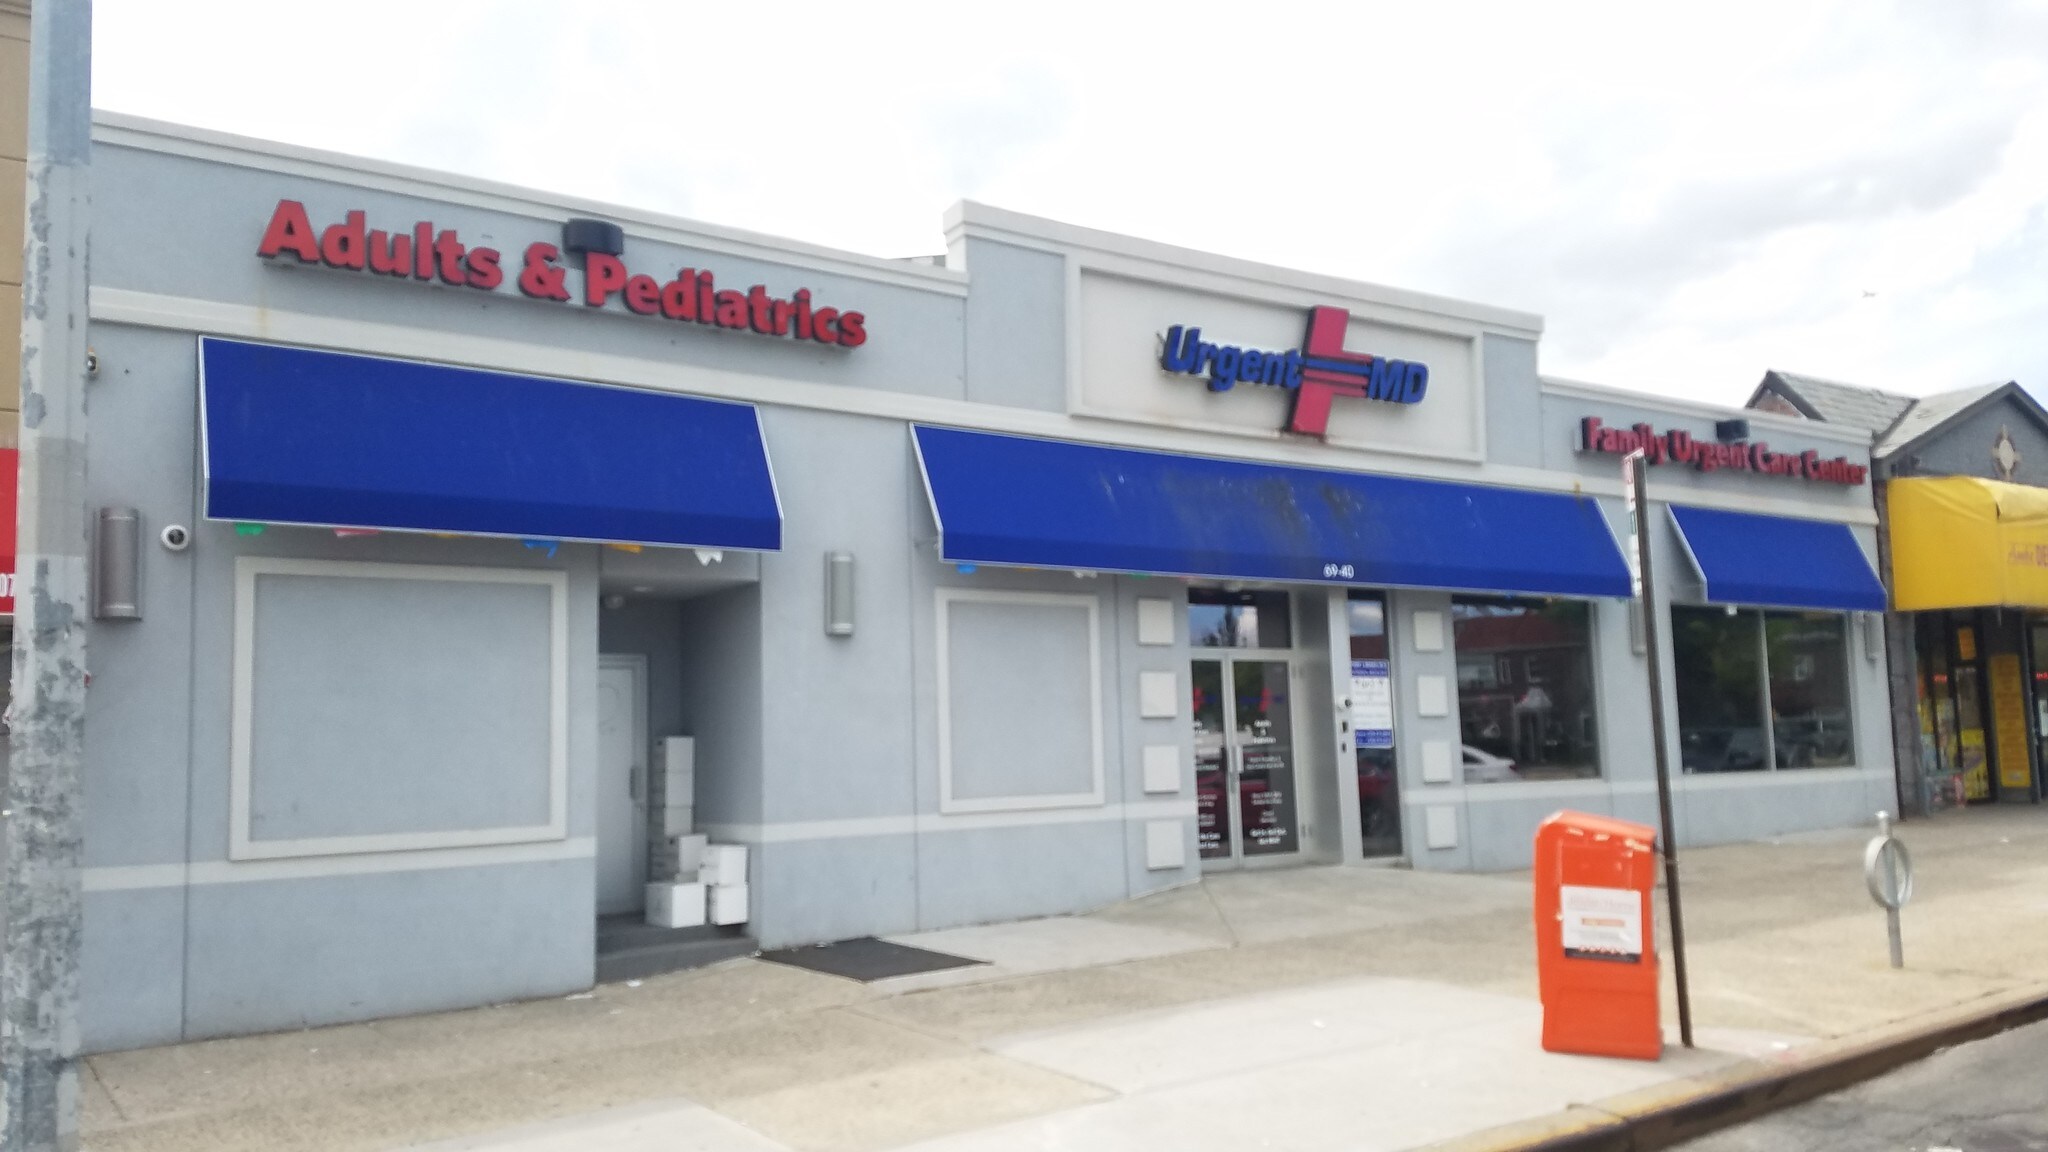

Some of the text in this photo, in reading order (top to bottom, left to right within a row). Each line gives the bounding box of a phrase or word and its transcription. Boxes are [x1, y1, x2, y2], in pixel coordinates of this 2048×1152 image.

[257, 198, 867, 347] Adults & Pediatrics
[1163, 323, 1430, 405] Urgent MD
[1582, 416, 1668, 466] Family
[1668, 429, 1751, 472] Urgent
[1750, 442, 1801, 477] Care
[1801, 449, 1868, 486] Center
[1323, 563, 1355, 579] 69-40
